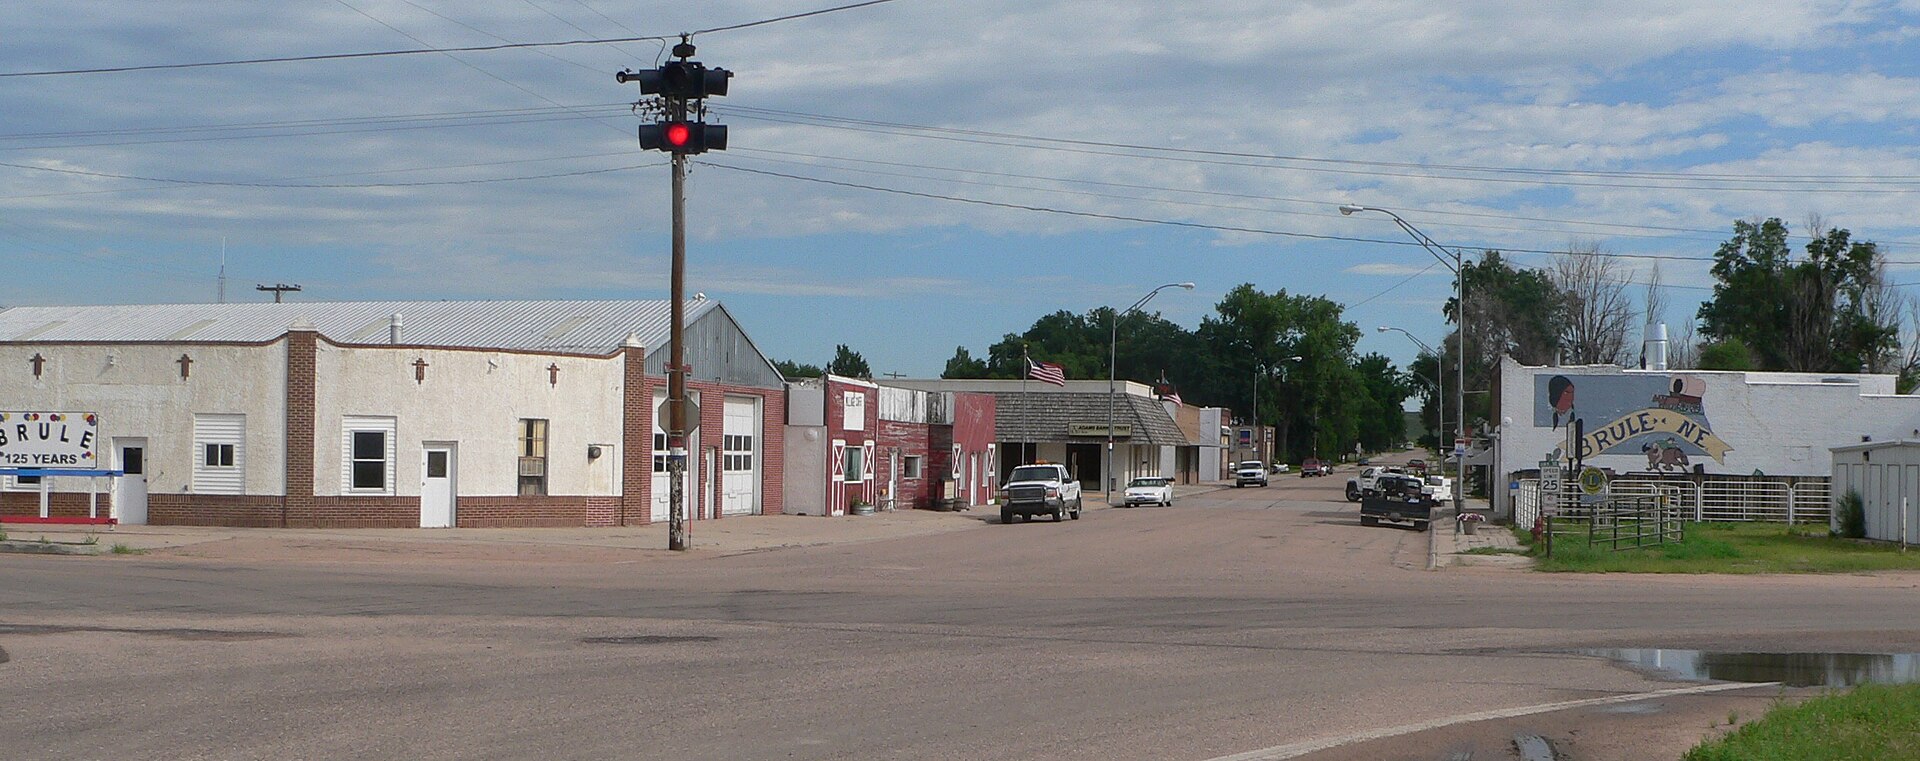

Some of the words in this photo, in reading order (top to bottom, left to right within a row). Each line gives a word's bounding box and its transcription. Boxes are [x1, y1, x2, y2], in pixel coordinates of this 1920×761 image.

[0, 422, 94, 449] BRULE
[1581, 412, 1655, 457] BRULE
[1676, 419, 1710, 448] NE
[5, 453, 28, 464] 125
[32, 453, 77, 464] YEARS
[1542, 480, 1558, 490] 25
